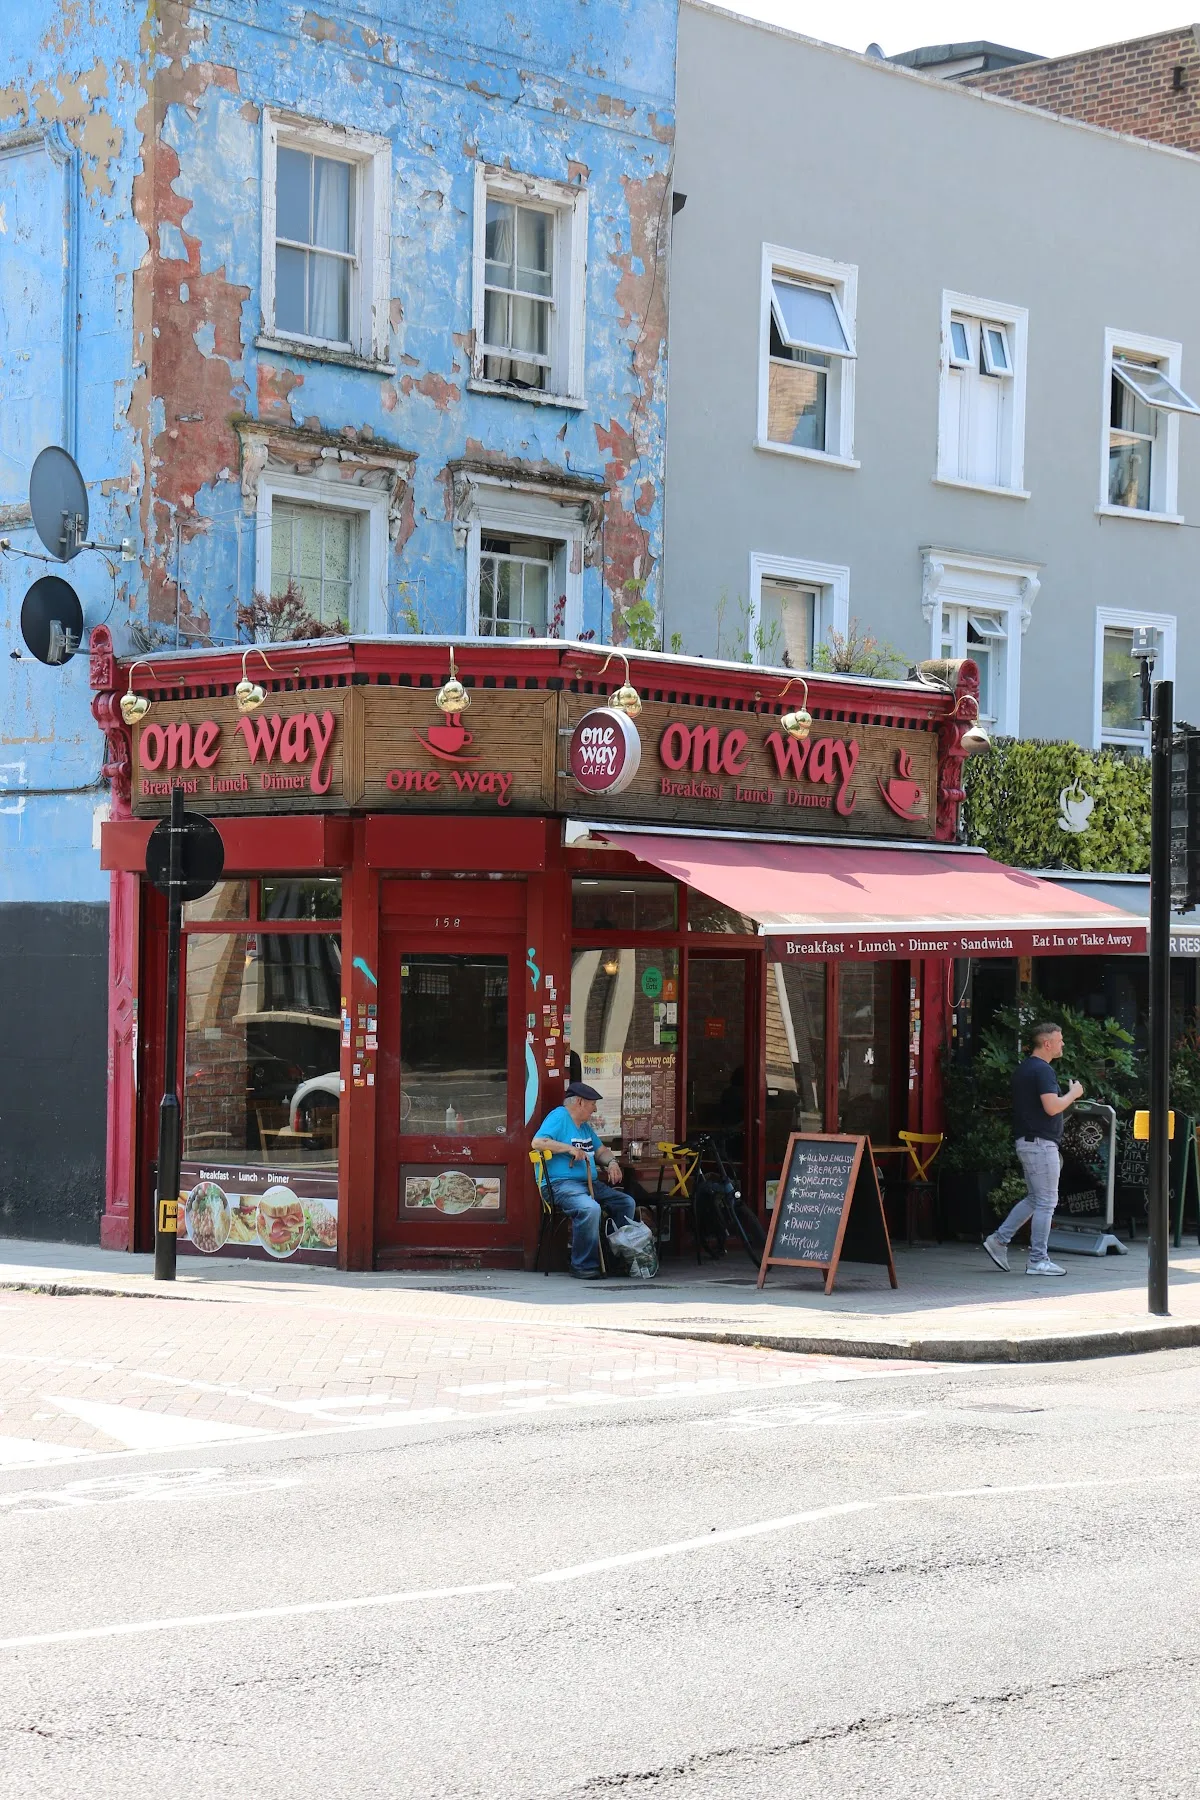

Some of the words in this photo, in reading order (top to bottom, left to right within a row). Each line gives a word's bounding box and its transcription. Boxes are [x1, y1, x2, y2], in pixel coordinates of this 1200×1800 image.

[581, 727, 615, 745] one
[140, 720, 223, 771] one
[234, 710, 336, 794] way
[578, 745, 617, 775] way
[581, 764, 606, 775] CAFE
[660, 722, 750, 776] one
[764, 730, 860, 816] way
[141, 776, 200, 795] Breakfast
[209, 773, 249, 793] Lunch
[260, 772, 307, 790] Dinner
[385, 769, 443, 792] one
[448, 770, 513, 807] way
[660, 777, 724, 800] Breakfast
[735, 784, 775, 804] Lunch
[787, 788, 833, 809] Dinner
[434, 917, 461, 928] 158
[786, 941, 845, 954] Breakfast
[857, 939, 897, 953] Lunch
[908, 938, 949, 951] Dinner
[960, 937, 1013, 950] Sandwich
[1032, 934, 1050, 947] Eat
[1053, 934, 1065, 946] In
[1067, 936, 1079, 946] or
[1081, 933, 1105, 945] Take
[1107, 933, 1133, 947] Away
[199, 1170, 229, 1181] Breakfast
[238, 1172, 258, 1181] Lunch
[267, 1173, 290, 1184] Dinner
